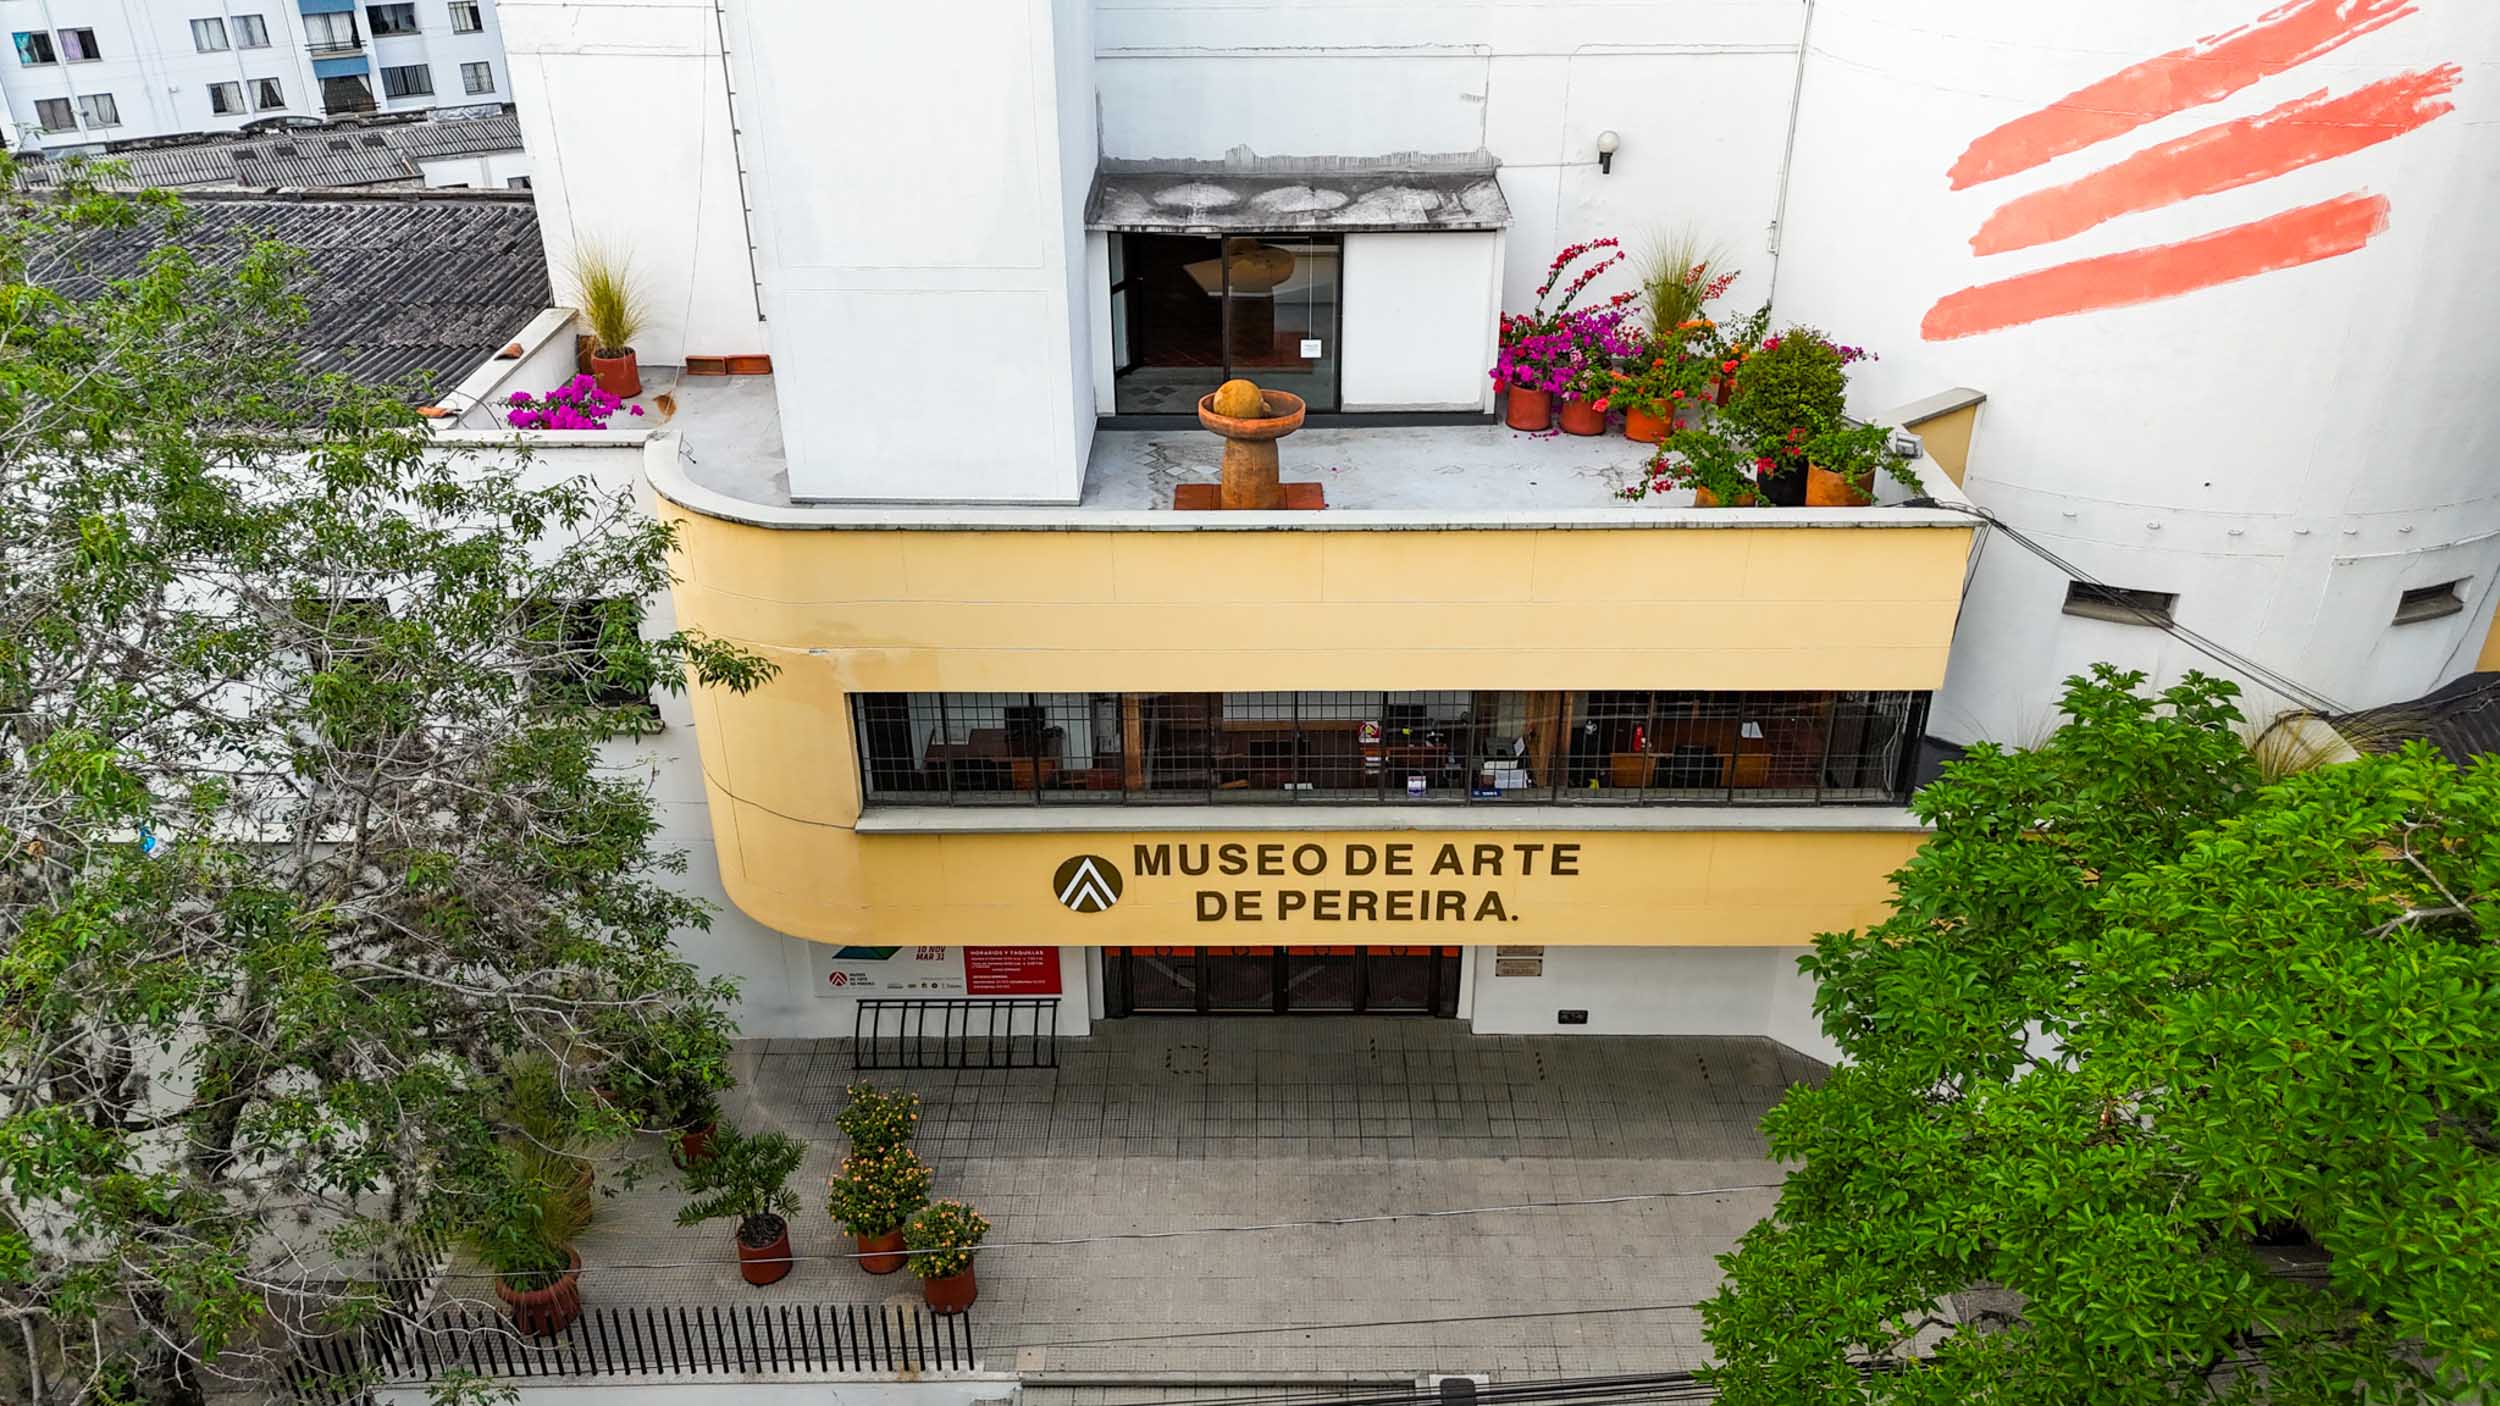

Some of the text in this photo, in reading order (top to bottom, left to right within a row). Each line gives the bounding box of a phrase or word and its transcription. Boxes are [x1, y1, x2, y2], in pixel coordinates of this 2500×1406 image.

[1133, 843, 1581, 876] MUSEO DE ARTE
[1196, 889, 1519, 922] DE PEREIRA.
